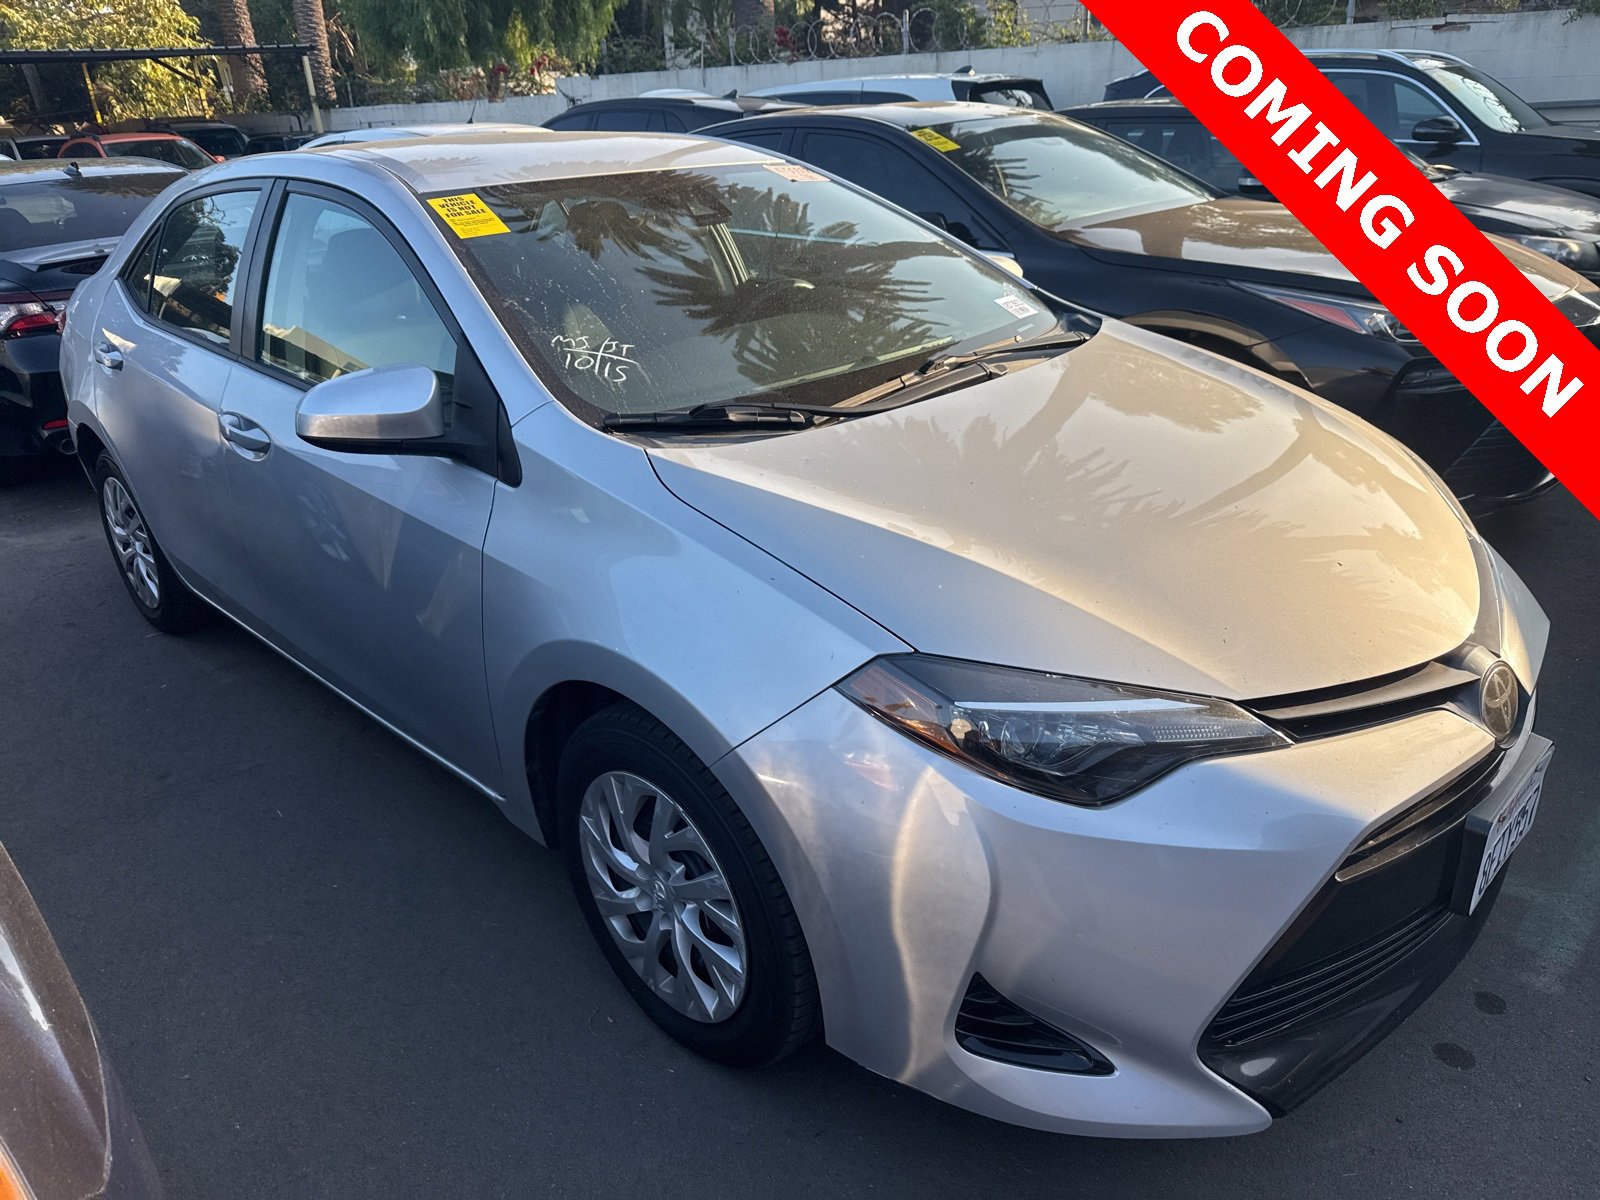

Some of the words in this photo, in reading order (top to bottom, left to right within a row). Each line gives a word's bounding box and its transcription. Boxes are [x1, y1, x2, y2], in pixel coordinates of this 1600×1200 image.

[438, 199, 477, 209] VEHICLE
[459, 204, 477, 212] NOT
[465, 208, 488, 216] SALE
